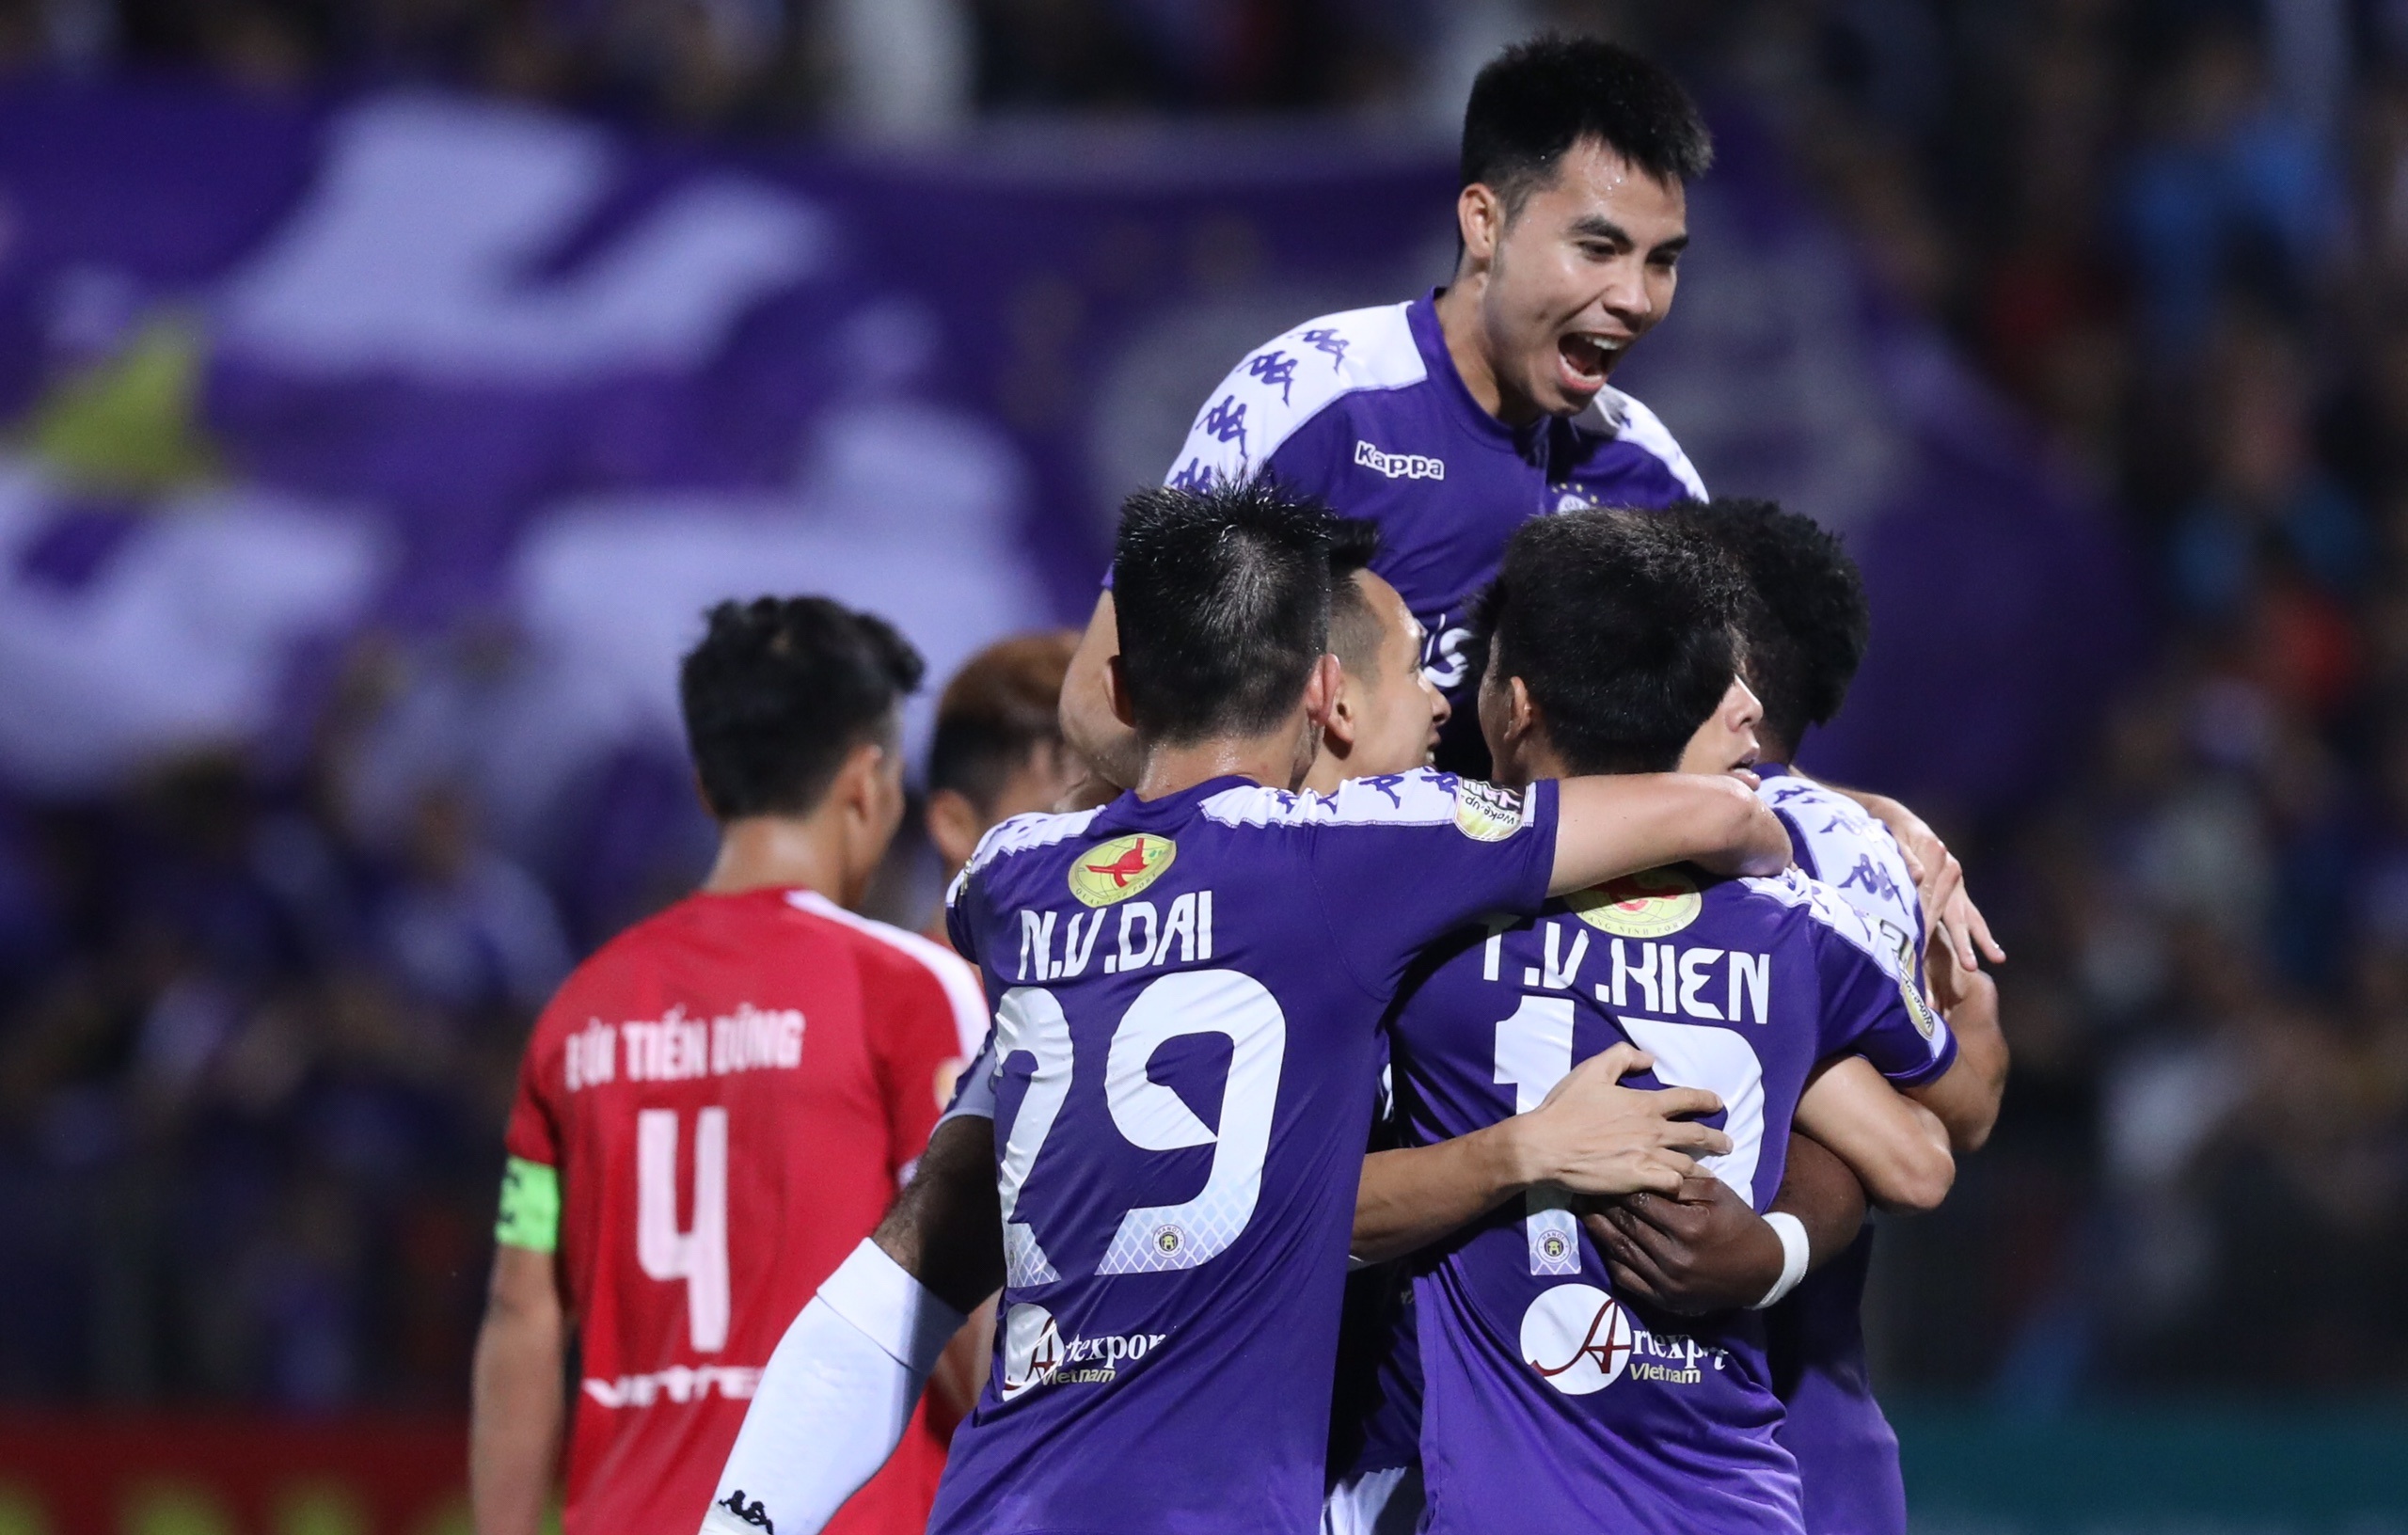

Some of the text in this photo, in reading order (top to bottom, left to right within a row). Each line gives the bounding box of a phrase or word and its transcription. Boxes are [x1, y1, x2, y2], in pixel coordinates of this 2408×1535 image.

[1354, 440, 1444, 481] Kappa
[1017, 891, 1213, 981] N.V.DAI
[993, 969, 1287, 1289] 29
[637, 1106, 732, 1353] 4
